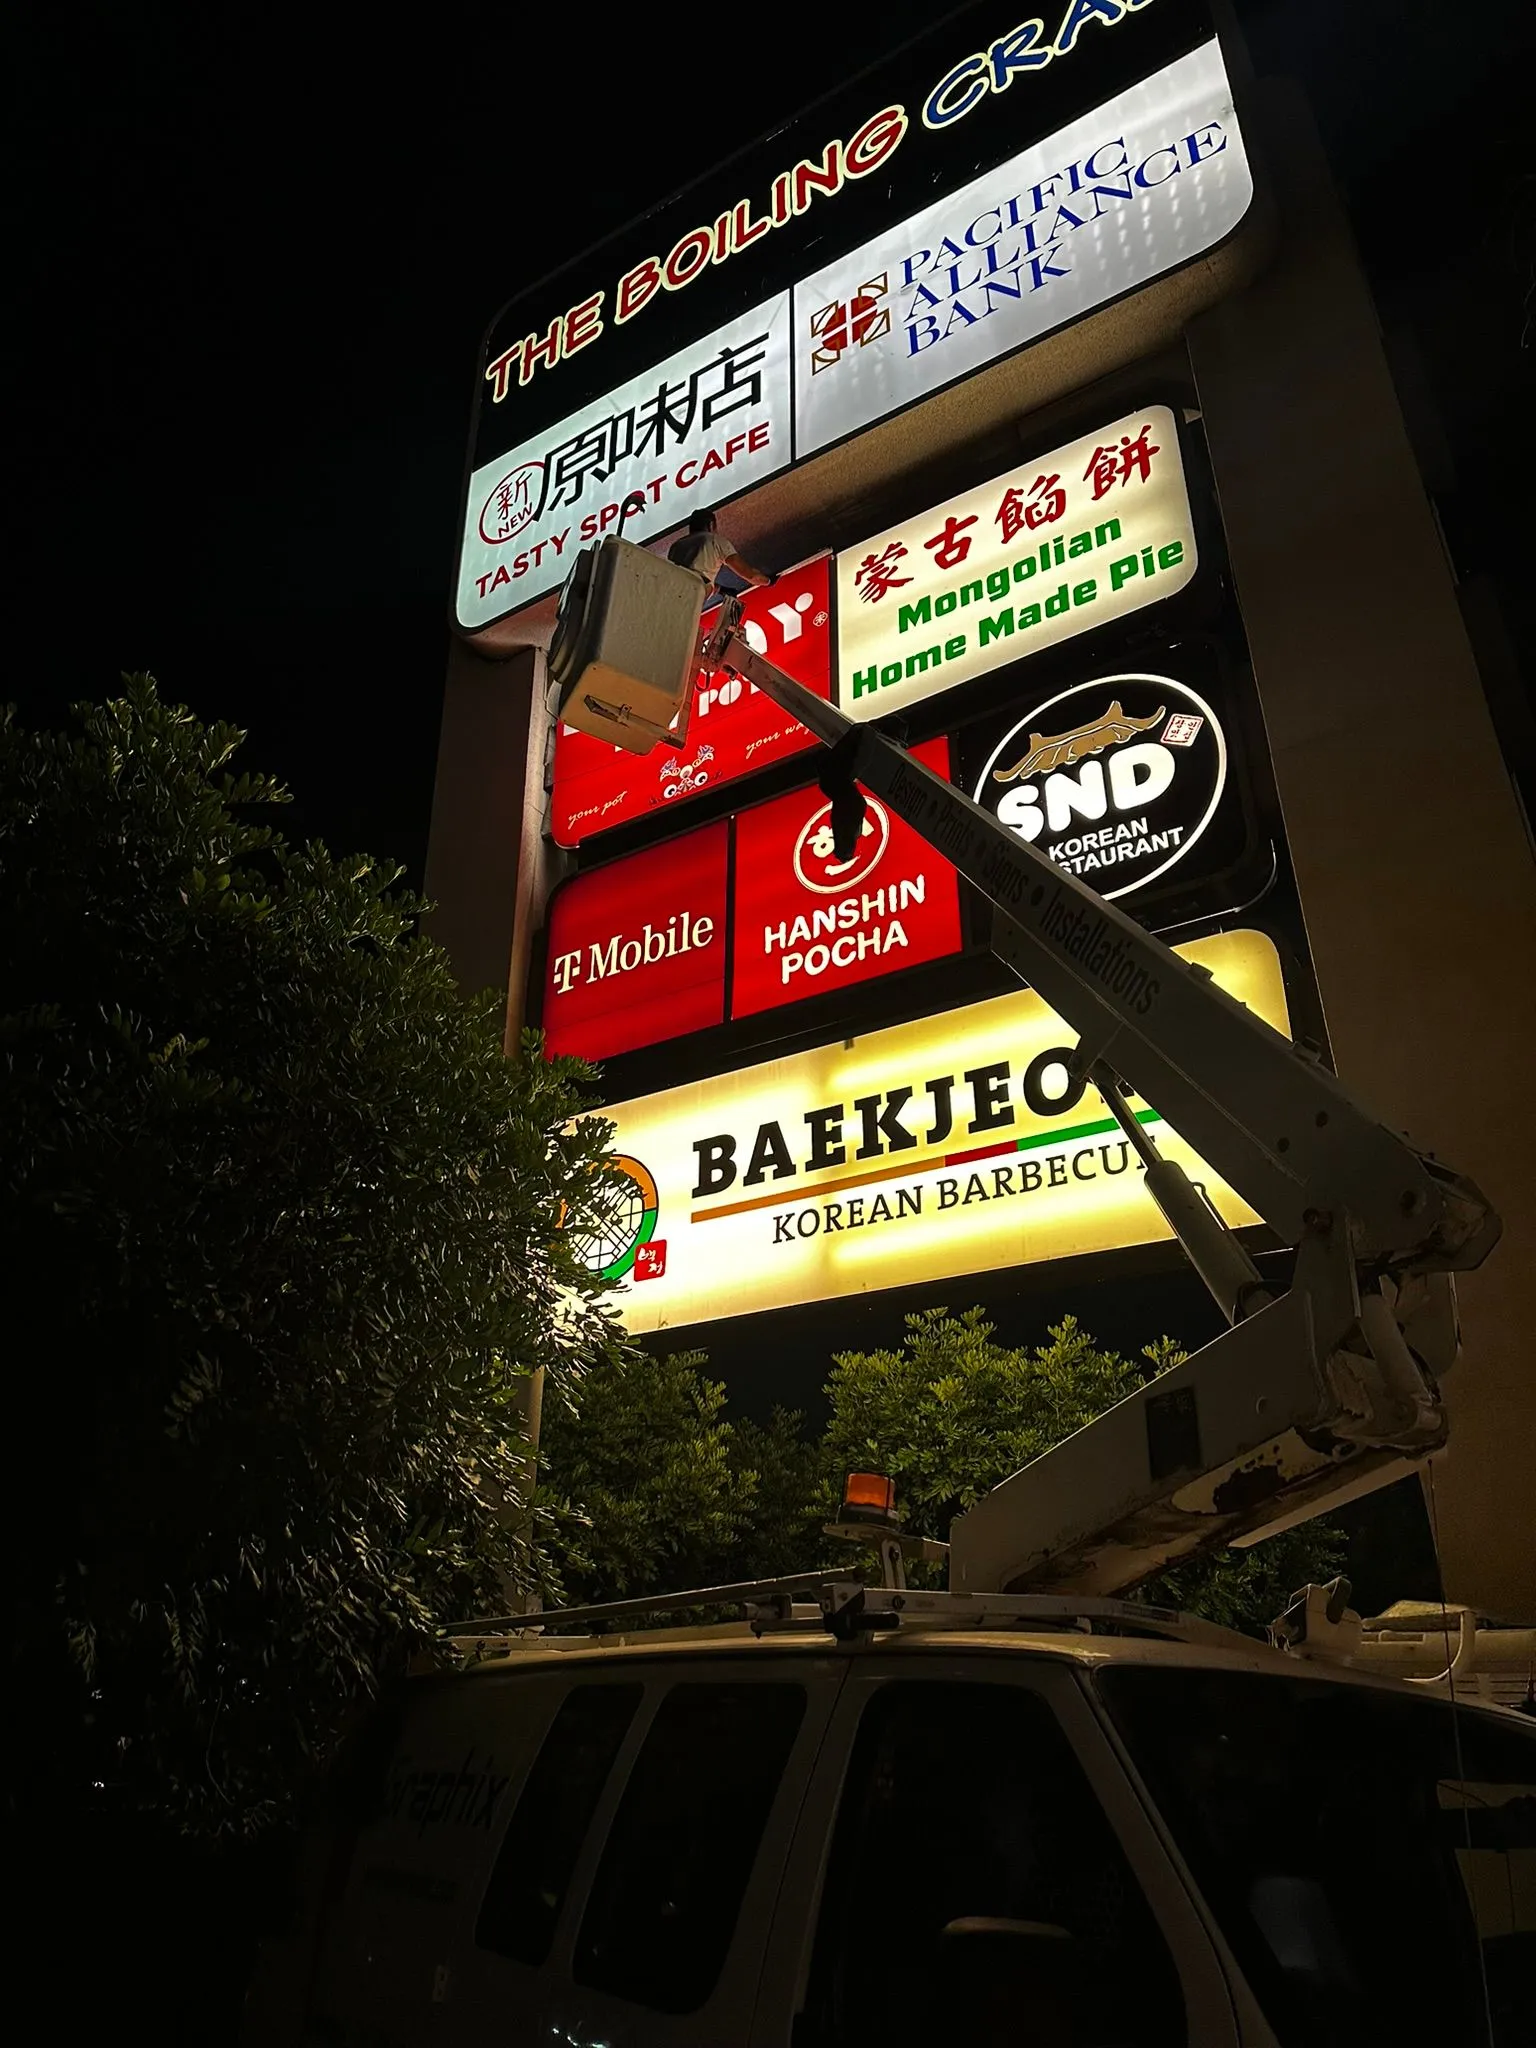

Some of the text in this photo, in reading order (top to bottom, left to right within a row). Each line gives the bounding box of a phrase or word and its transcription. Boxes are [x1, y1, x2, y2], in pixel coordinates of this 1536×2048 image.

[485, 0, 1152, 403] THE BOILING CRA
[901, 136, 1132, 289] PACIFIC
[904, 121, 1227, 320] ALLIANCE
[905, 243, 1075, 358] BANK
[533, 332, 770, 522] 原味店
[475, 421, 770, 598] TASTY SPOT CAFE
[496, 470, 533, 520] 新
[498, 502, 532, 538] NEW
[854, 424, 1160, 603] 蒙古餡餅
[852, 540, 1185, 699] Home Made Pie
[898, 517, 1121, 633] Mongolian
[601, 791, 628, 816] pot
[997, 742, 1175, 842] SND
[1048, 817, 1149, 861] KOREAN
[887, 763, 1160, 1014] Design Prints Signs Installations
[1058, 826, 1184, 874] STAURANT
[586, 911, 714, 983] Mobile
[764, 874, 925, 954] HANSHIN
[781, 920, 908, 984] POCHA
[690, 1046, 1134, 1199] BAEKJEO
[771, 1135, 1155, 1244] KOREAN BARBECU
